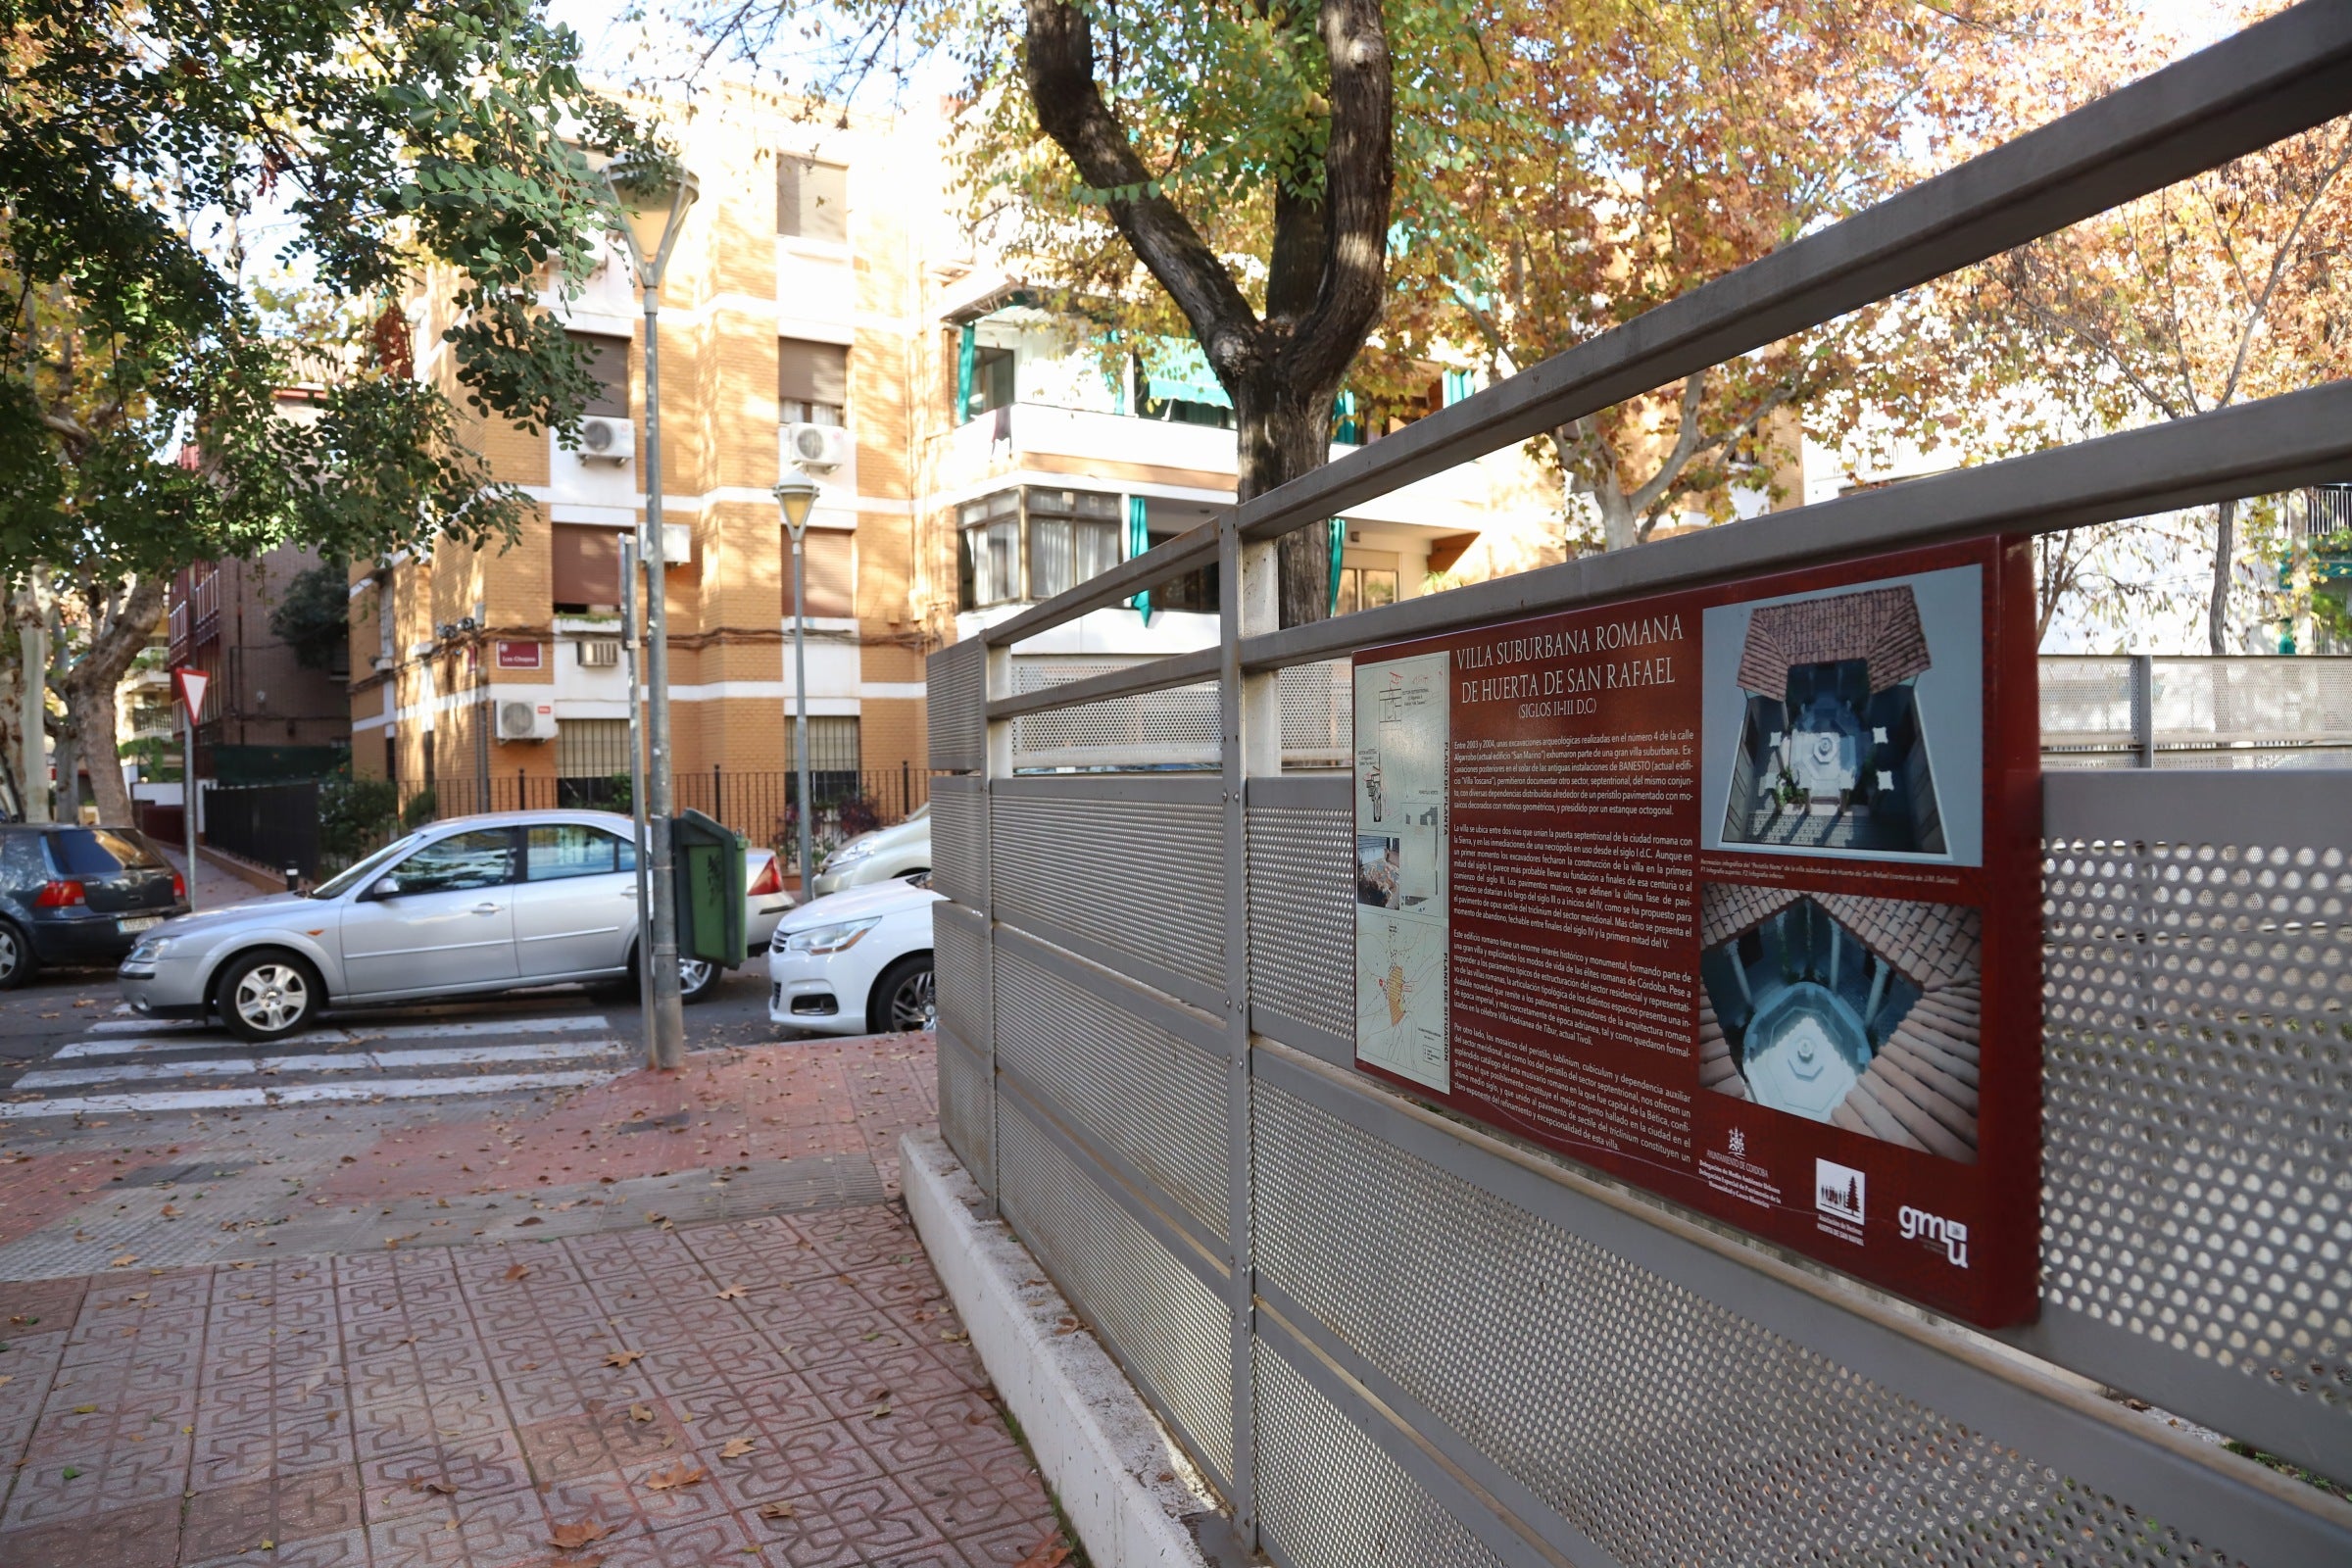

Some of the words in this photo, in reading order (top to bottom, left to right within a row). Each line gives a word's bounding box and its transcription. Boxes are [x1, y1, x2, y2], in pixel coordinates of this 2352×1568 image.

[1457, 645, 1493, 670] VILLA
[1497, 629, 1590, 665] SUBURBANA
[1596, 614, 1683, 651] ROMANA
[1462, 682, 1478, 703] DE
[1482, 674, 1539, 701] HUERTA
[1544, 670, 1563, 696] DE
[1568, 665, 1601, 693] SAN
[1607, 657, 1675, 689] RAFAEL
[1519, 702, 1551, 719] (SIGLOS
[1554, 700, 1573, 716] II-III
[1678, 729, 1694, 740] calle
[1614, 750, 1628, 759] gran
[1629, 747, 1642, 756] villa
[1683, 745, 1693, 755] Ex-
[1619, 761, 1651, 771] BANESTO
[1652, 761, 1674, 771] (actual
[1676, 760, 1693, 770] edifi-
[1444, 780, 1449, 793] DE
[1591, 776, 1631, 787] septentrional,
[1632, 775, 1643, 785] del
[1668, 778, 1693, 788] conjun-
[1597, 790, 1621, 800] peristilo
[1623, 791, 1664, 801] pavimentado
[1589, 806, 1599, 815] por
[1609, 806, 1637, 815] estanque
[1639, 806, 1673, 817] octogonal.
[1629, 833, 1651, 843] ciudad
[1653, 837, 1678, 845] romana
[1593, 845, 1612, 855] desde
[1620, 847, 1635, 859] siglo
[1655, 850, 1682, 862] Aunque
[1631, 862, 1644, 872] villa
[1666, 867, 1692, 877] primera
[1606, 873, 1625, 884] finales
[1650, 881, 1677, 890] centuria
[1590, 886, 1612, 897] definen
[1624, 890, 1643, 901] última
[1646, 892, 1659, 903] fase
[1675, 898, 1692, 908] pavi-
[1586, 899, 1595, 909] del
[1605, 904, 1622, 912] como
[1641, 909, 1675, 919] propuesto
[1676, 914, 1692, 922] para
[1615, 917, 1627, 928] Más
[1629, 919, 1644, 930] claro
[1655, 926, 1684, 936] presenta
[1606, 933, 1630, 942] primera
[1631, 935, 1649, 945] mitad
[1651, 937, 1661, 947] del
[1589, 957, 1628, 971] monumental,
[1630, 962, 1661, 977] formando
[1663, 971, 1680, 980] parte
[1601, 973, 1626, 984] romanas
[1637, 978, 1667, 993] Córdoba.
[1670, 984, 1685, 997] Pese
[1444, 990, 1448, 1003] DE
[1590, 985, 1608, 994] sector
[1610, 989, 1642, 1001] residencial
[1649, 998, 1691, 1012] representati-
[1586, 995, 1610, 1009] distintos
[1611, 1003, 1638, 1015] espacios
[1639, 1010, 1667, 1022] presenta
[1668, 1017, 1681, 1026] una
[1625, 1021, 1663, 1036] arquitectura
[1665, 1031, 1691, 1043] romana
[1615, 1032, 1633, 1042] como
[1634, 1037, 1665, 1051] quedaron
[1666, 1043, 1690, 1057] formal-
[1582, 1063, 1613, 1078] cubiculum
[1621, 1074, 1663, 1094] dependencia
[1666, 1090, 1690, 1102] auxiliar
[1598, 1083, 1640, 1102] septentrional,
[1641, 1097, 1653, 1106] nos
[1654, 1099, 1680, 1114] ofrecen
[1584, 1092, 1596, 1101] que
[1597, 1093, 1606, 1105] fue
[1608, 1100, 1628, 1111] capital
[1647, 1110, 1669, 1127] Bética,
[1671, 1121, 1690, 1132] confi-
[1605, 1110, 1628, 1126] hallado
[1648, 1126, 1671, 1141] ciudad
[1592, 1135, 1604, 1145] esta
[1606, 1139, 1619, 1151] villa.
[1598, 1121, 1607, 1132] del
[1610, 1127, 1639, 1143] triclinium
[1641, 1139, 1679, 1158] constituyen
